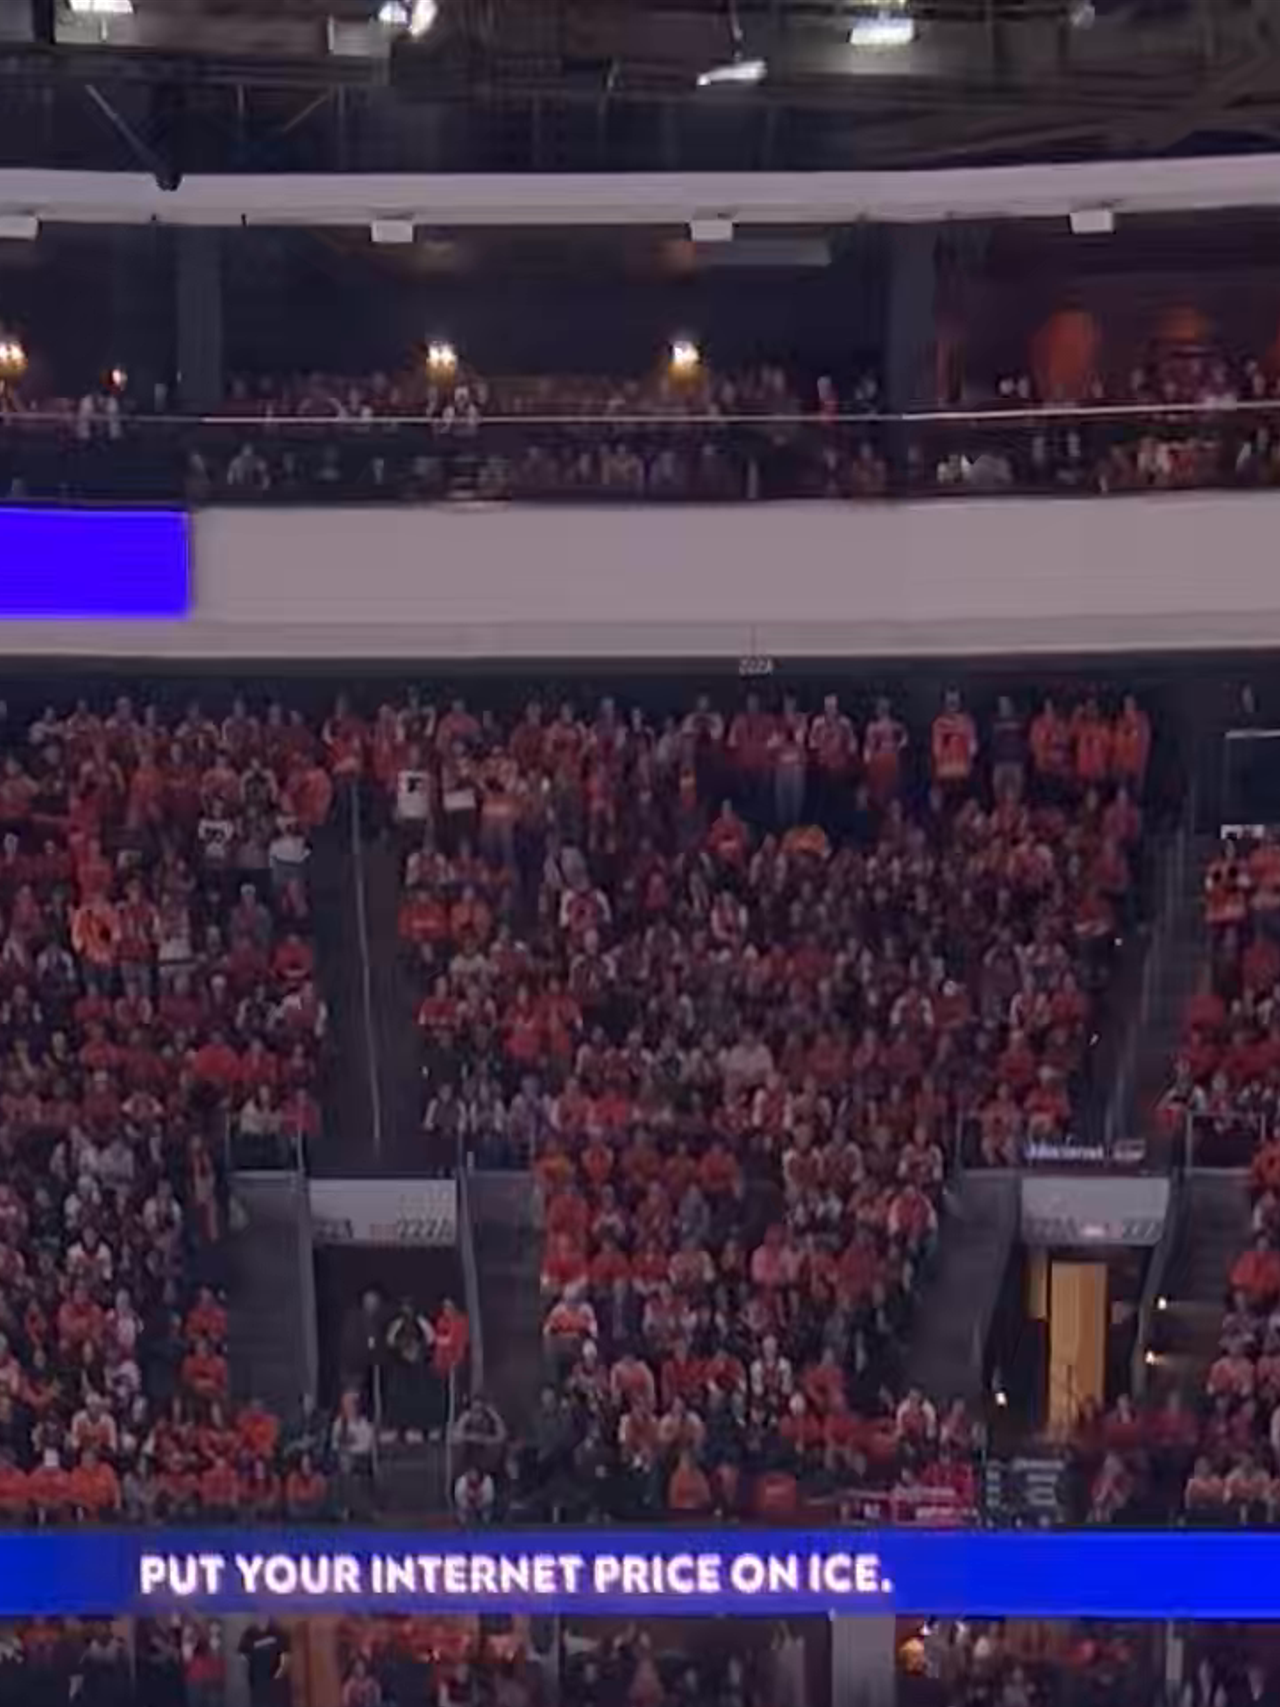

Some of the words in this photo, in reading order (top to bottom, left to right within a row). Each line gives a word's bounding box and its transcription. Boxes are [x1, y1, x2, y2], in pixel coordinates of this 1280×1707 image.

[140, 1553, 226, 1596] PUT
[235, 1553, 362, 1595] YOUR
[371, 1553, 584, 1595] INTERNET
[593, 1553, 722, 1595] PRICE
[730, 1552, 799, 1595] ON
[809, 1552, 894, 1595] ICE.
